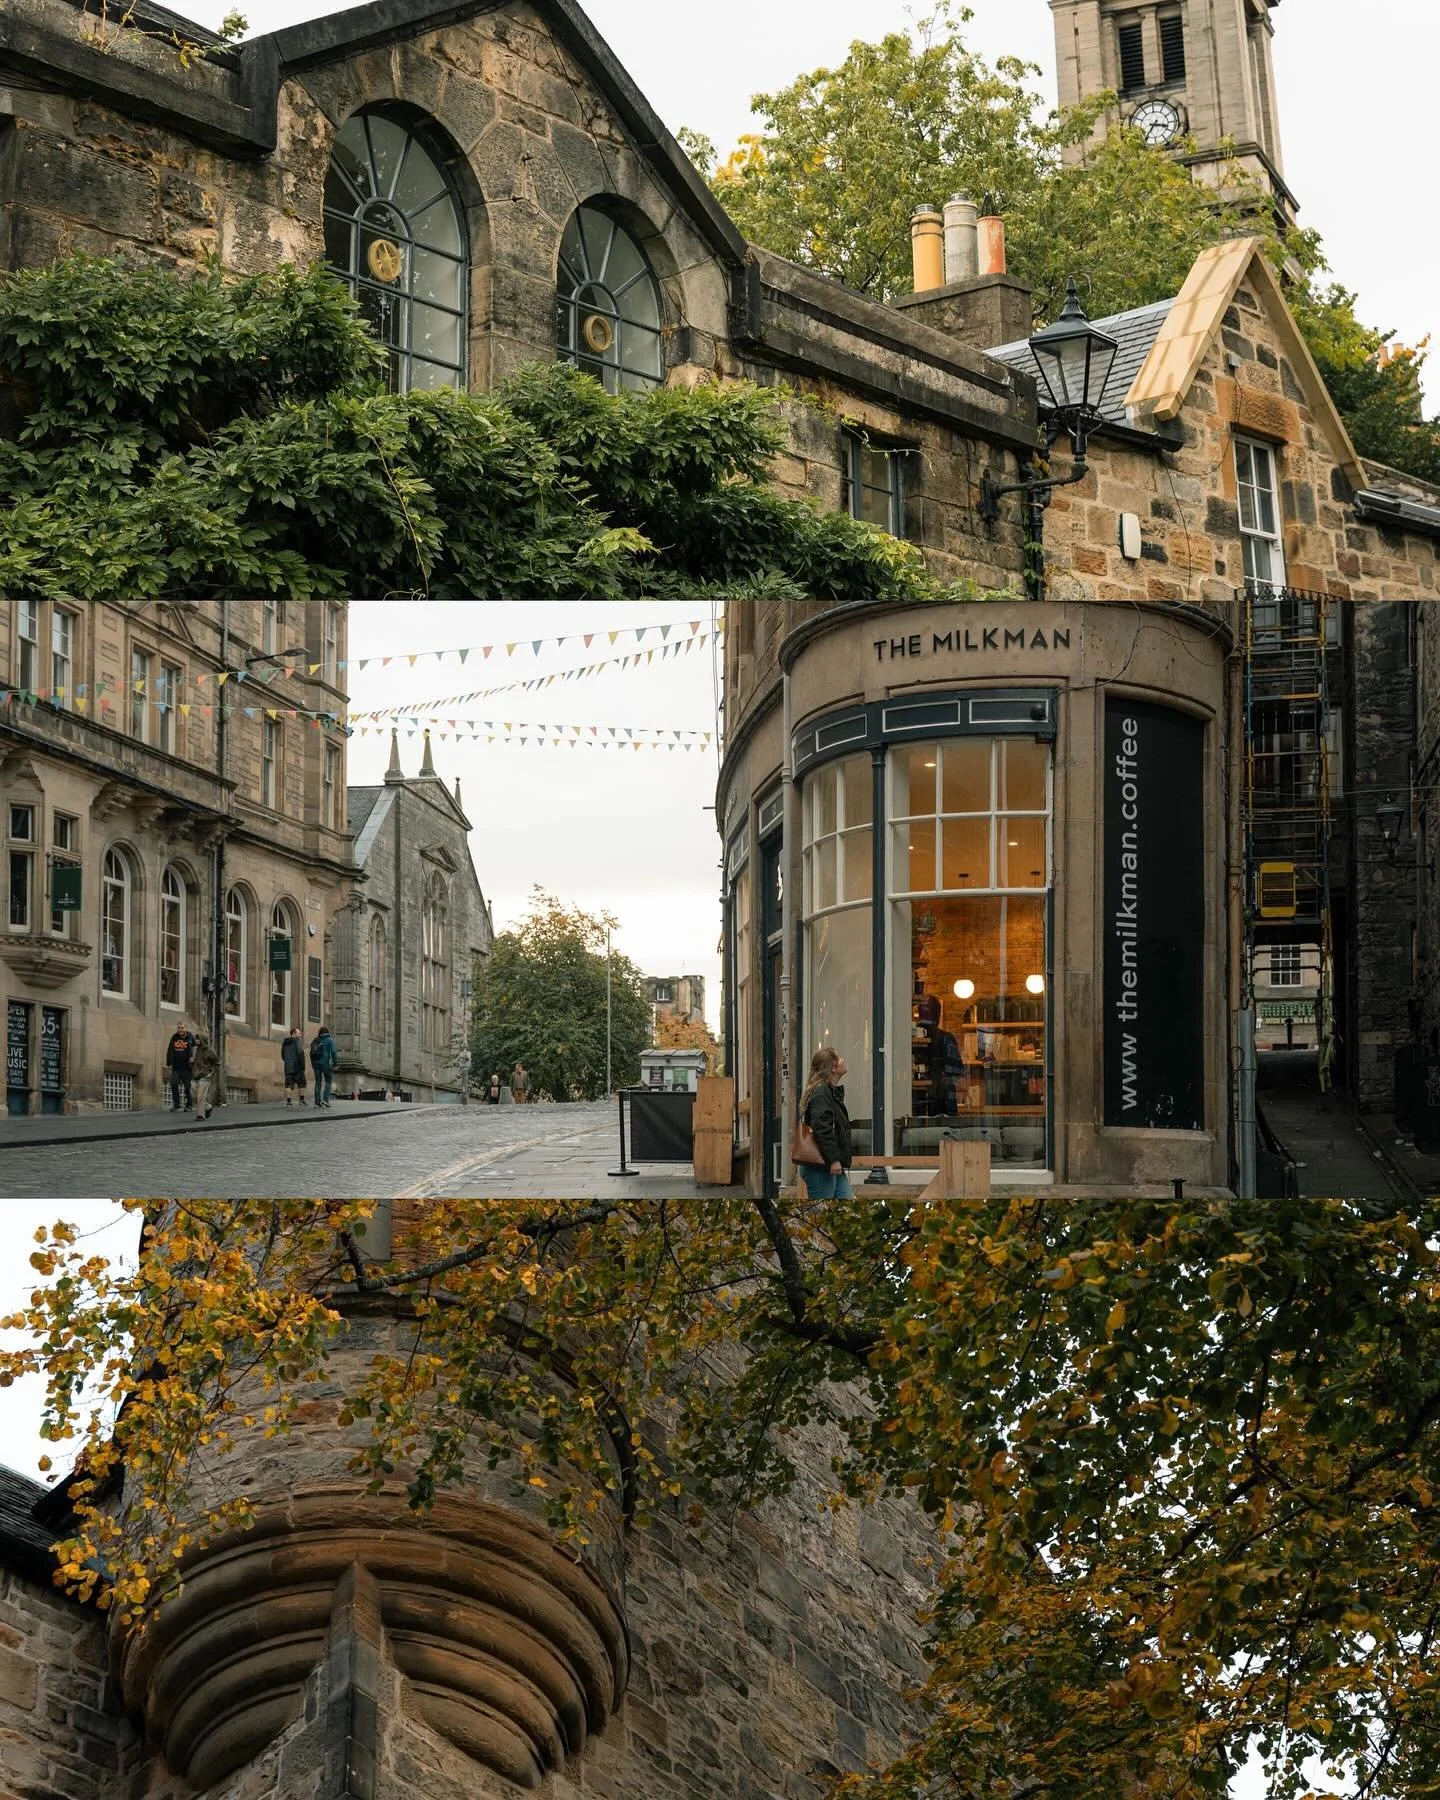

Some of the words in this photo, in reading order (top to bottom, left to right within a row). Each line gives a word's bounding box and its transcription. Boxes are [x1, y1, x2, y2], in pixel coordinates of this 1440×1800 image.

[873, 634, 921, 661] THE
[933, 627, 1071, 653] MILKMAN
[1116, 718, 1138, 1022] themilkman.coffee
[8, 1058, 27, 1069] USIC
[1122, 1032, 1137, 1110] www
